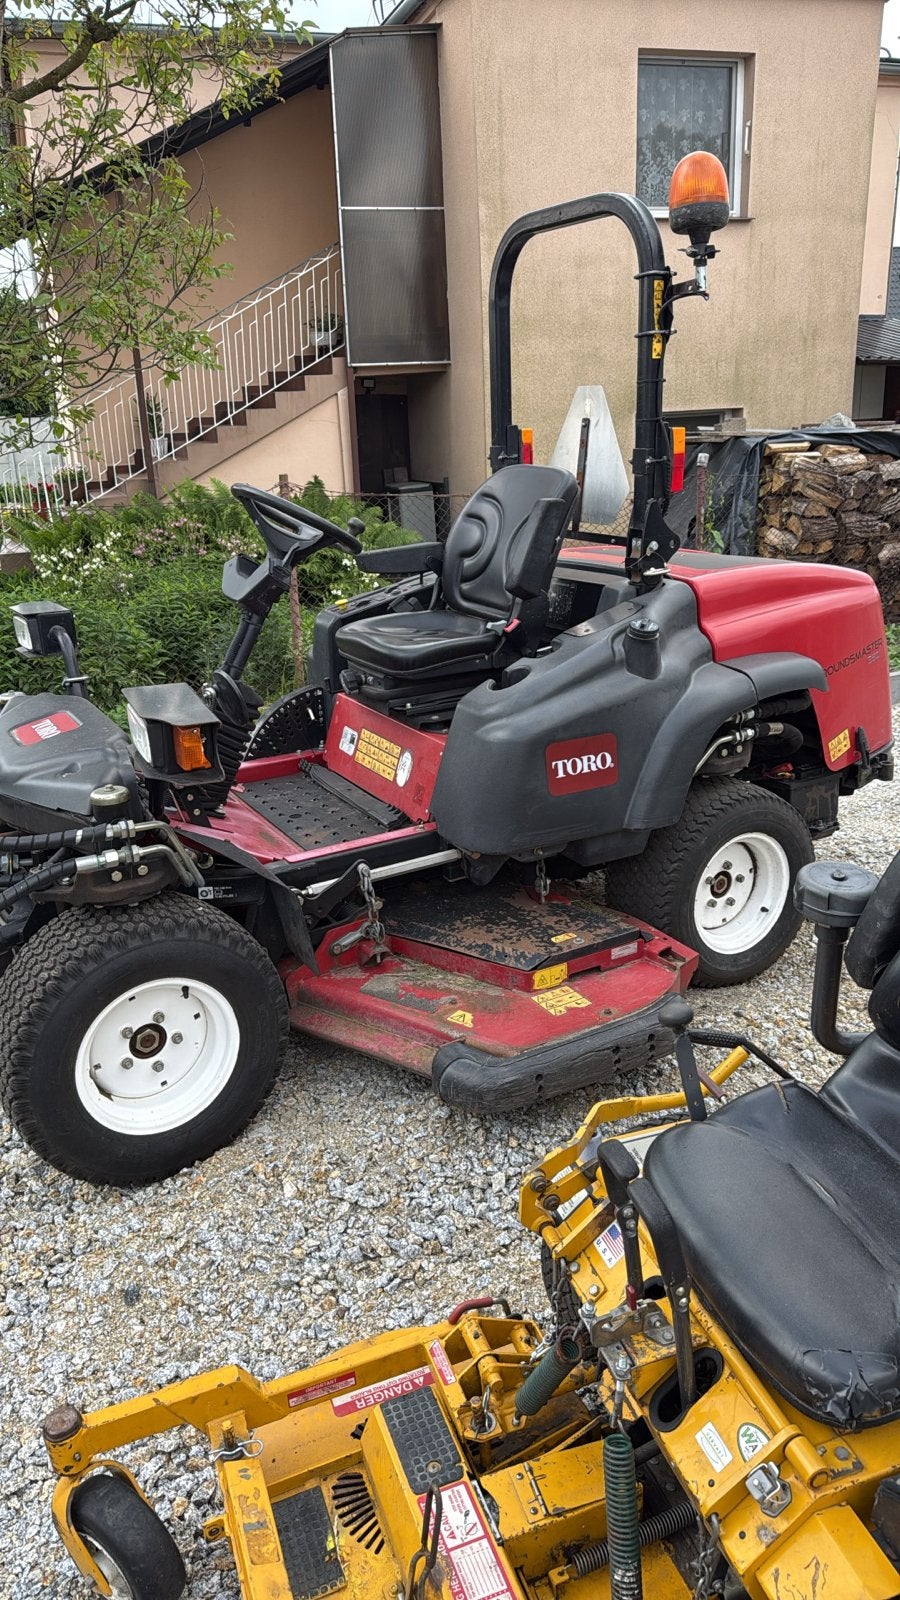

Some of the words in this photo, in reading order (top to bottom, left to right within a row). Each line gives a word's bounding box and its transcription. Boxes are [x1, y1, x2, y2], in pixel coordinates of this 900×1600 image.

[823, 638, 882, 677] ROUNDSMASTER
[32, 719, 61, 739] TORO
[552, 752, 612, 778] TORO
[355, 1381, 413, 1409] DANGER
